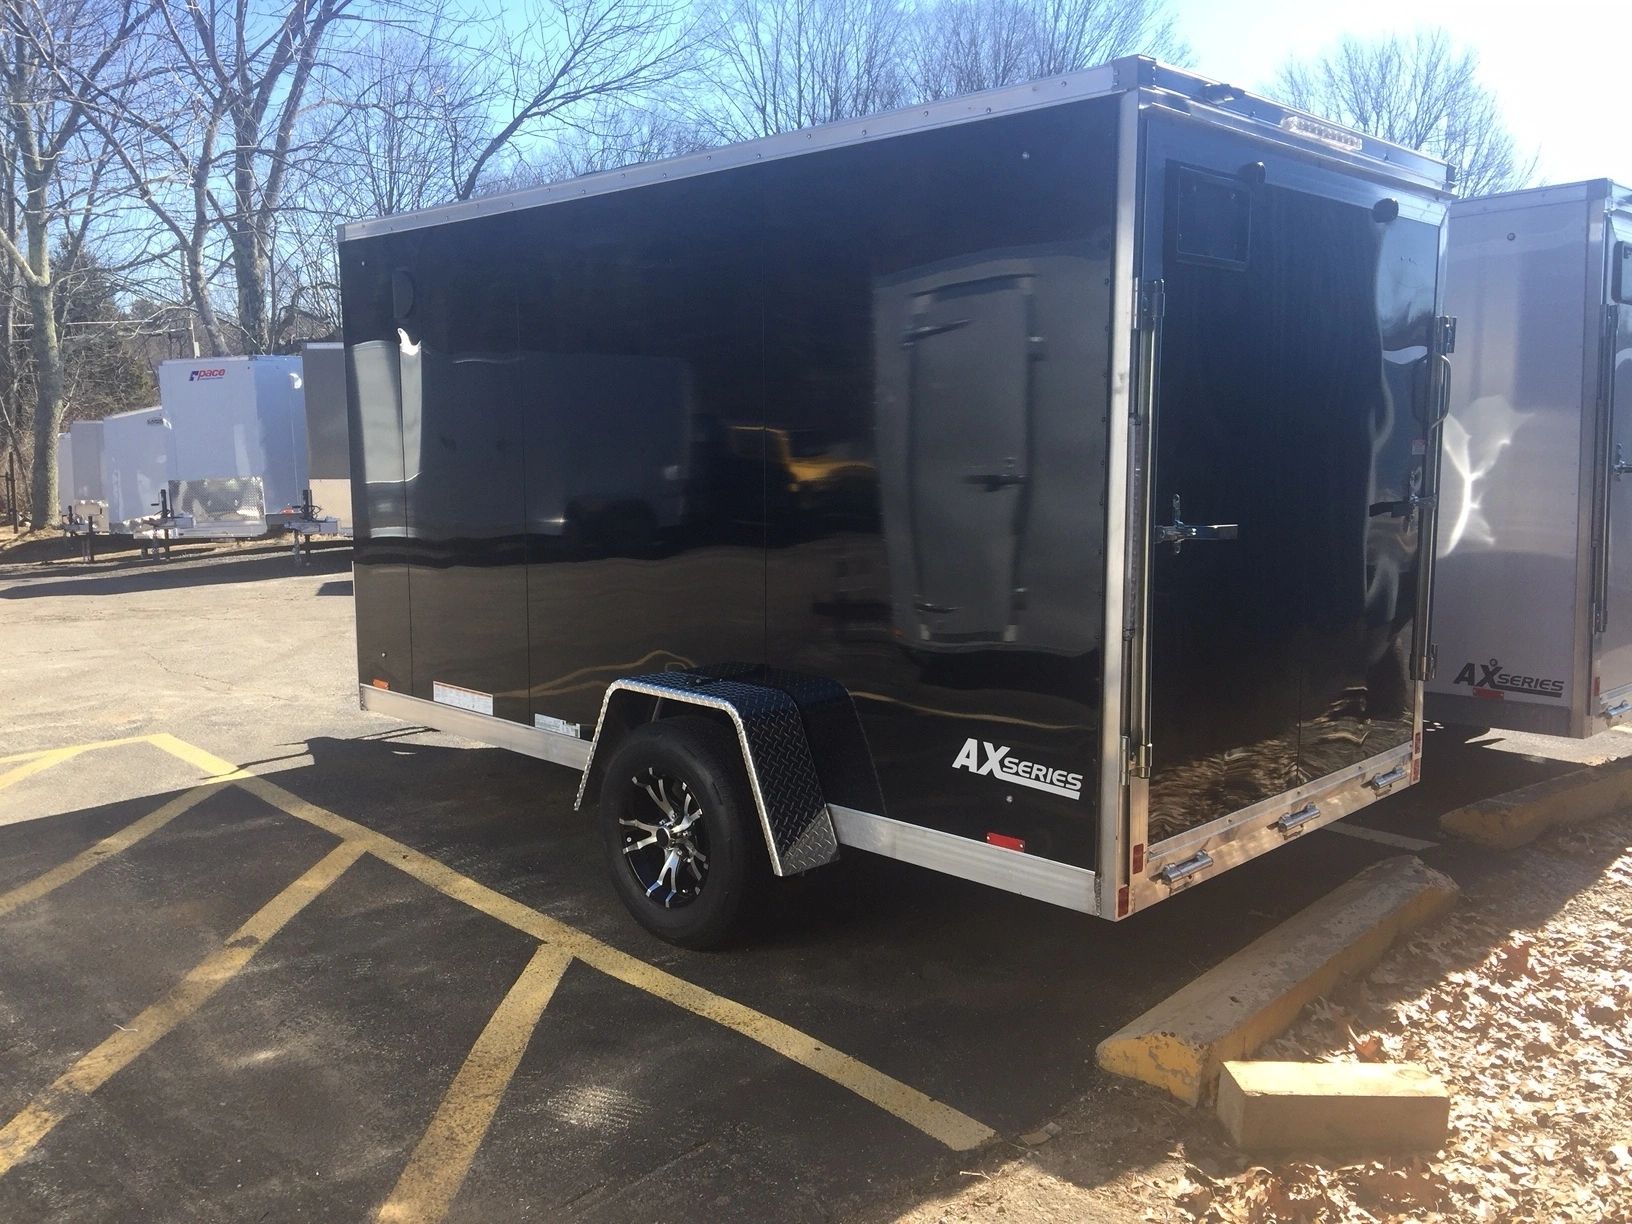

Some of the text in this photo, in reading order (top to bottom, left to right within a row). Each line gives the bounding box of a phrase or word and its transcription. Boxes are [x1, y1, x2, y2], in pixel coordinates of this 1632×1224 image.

[197, 369, 226, 381] pace
[1453, 662, 1565, 692] AX SERIES
[952, 737, 1084, 791] AX SERIES
